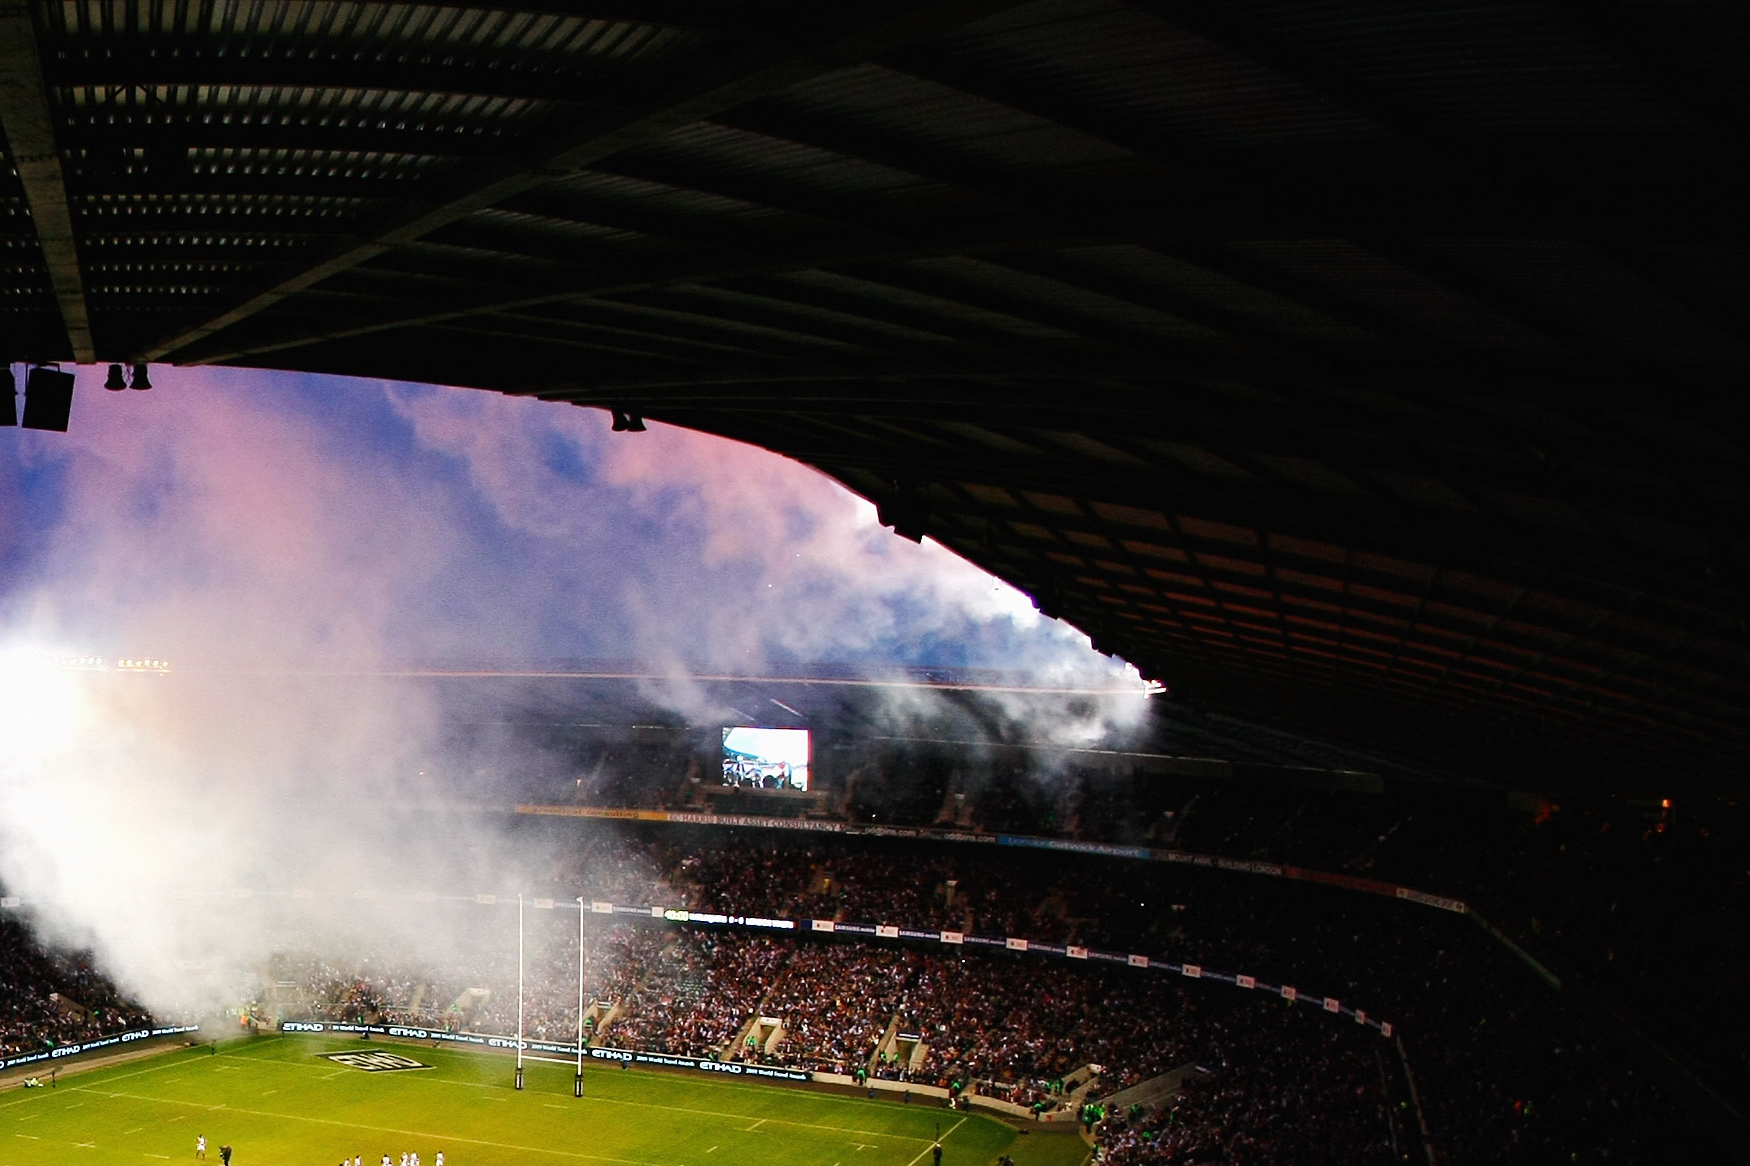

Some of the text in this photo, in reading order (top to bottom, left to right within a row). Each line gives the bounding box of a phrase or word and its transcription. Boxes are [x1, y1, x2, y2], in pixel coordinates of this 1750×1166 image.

[944, 833, 995, 843] oddbins.com
[1049, 840, 1095, 851] Gatwick
[1096, 846, 1140, 857] Airport
[283, 1023, 323, 1032] ETIHAD
[389, 1028, 427, 1038] ETIHAD
[122, 1030, 149, 1042] ETIHAD
[52, 1046, 80, 1057] ETIHAD
[592, 1050, 632, 1061] ETIHAD
[700, 1062, 741, 1074] ETIHAD
